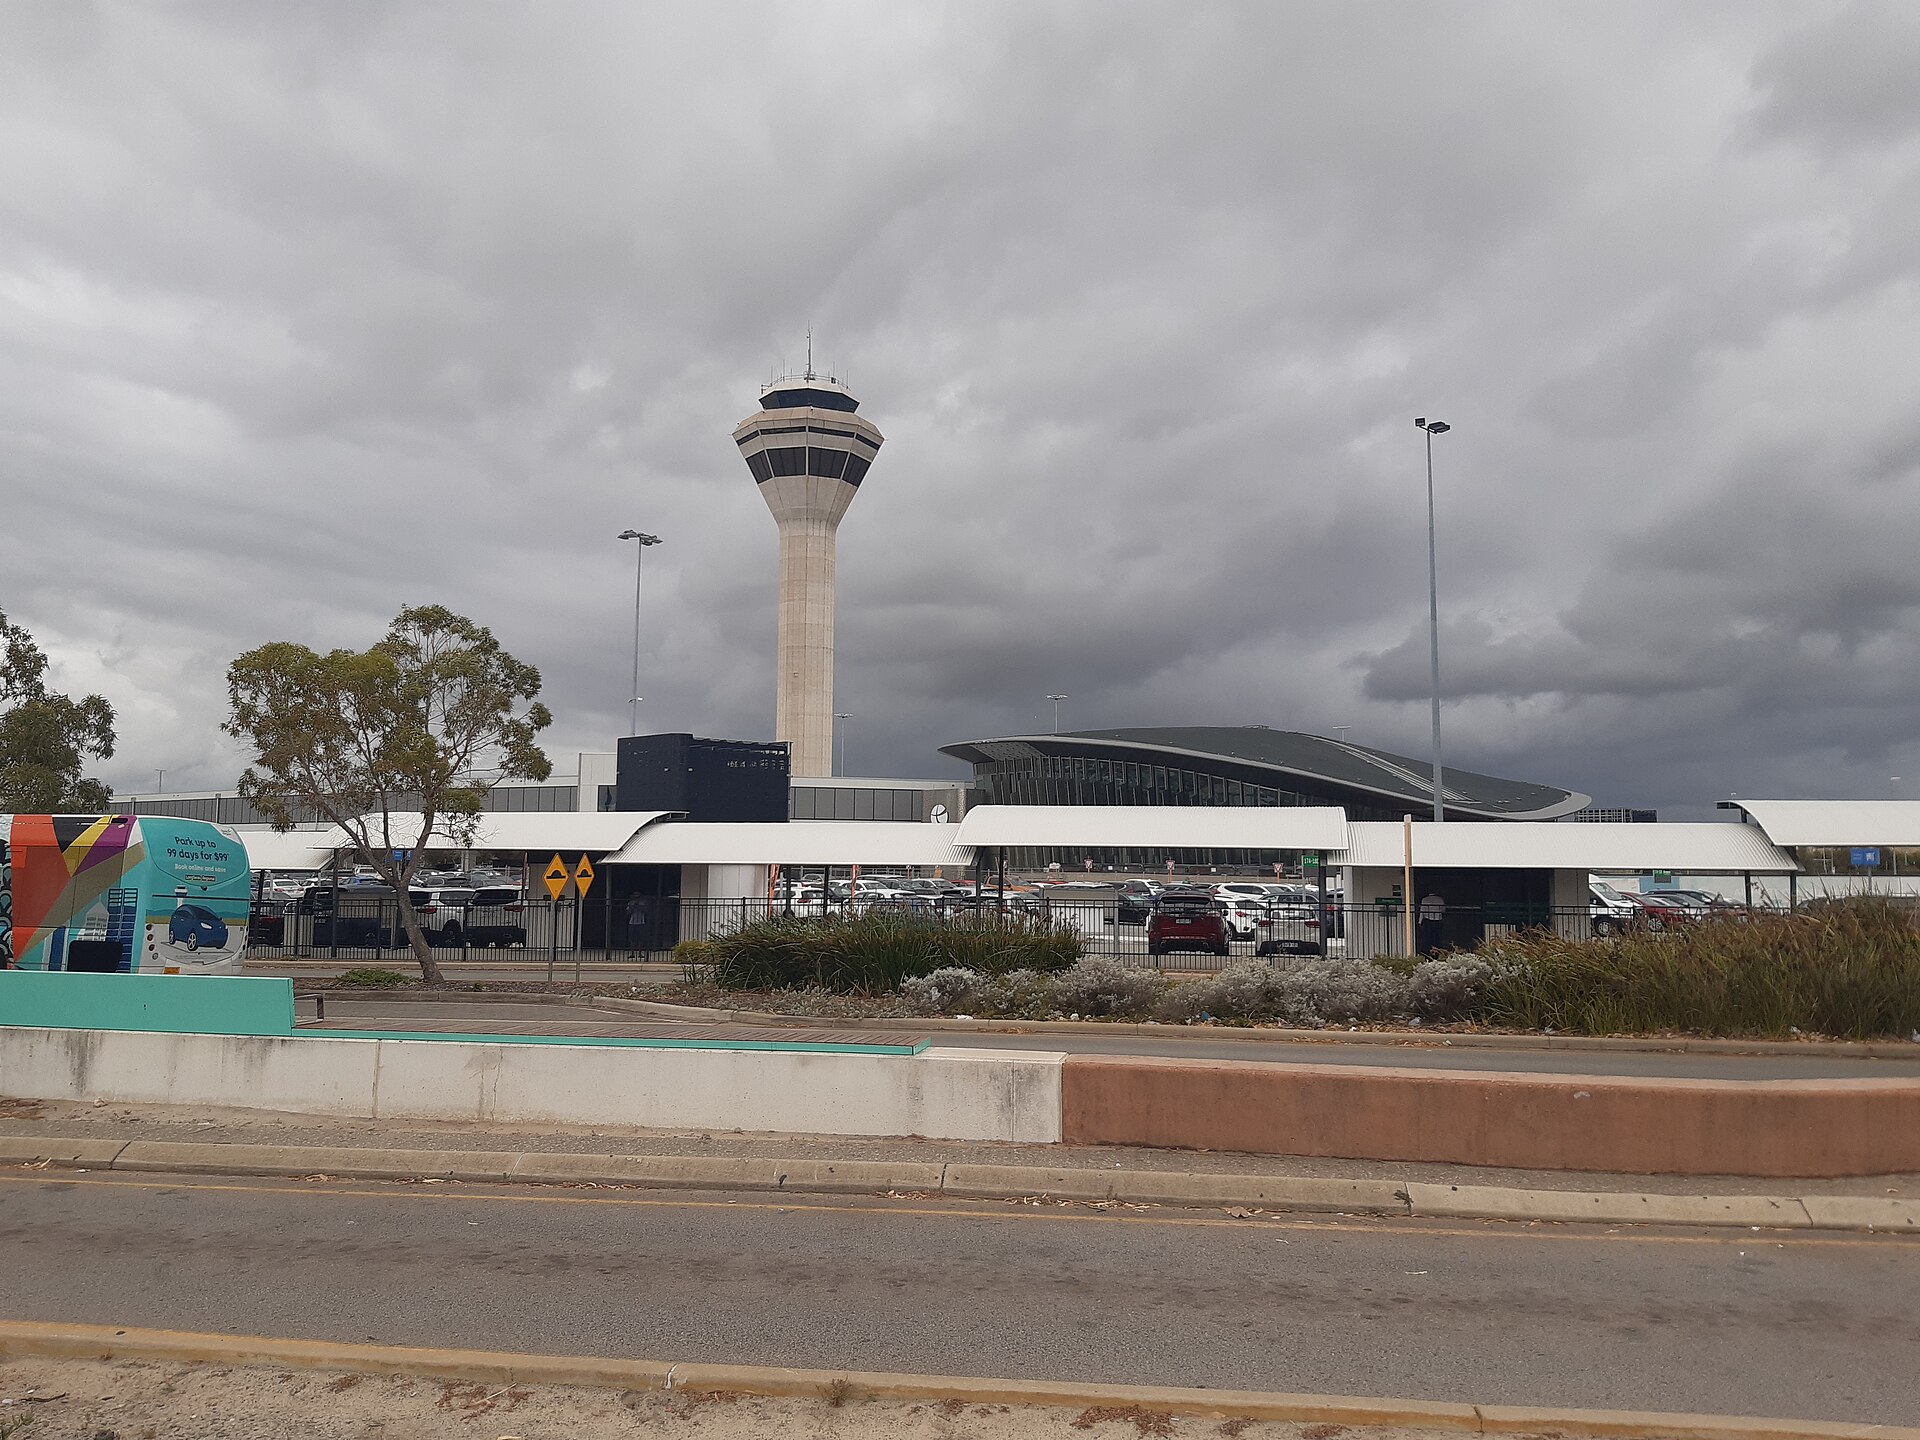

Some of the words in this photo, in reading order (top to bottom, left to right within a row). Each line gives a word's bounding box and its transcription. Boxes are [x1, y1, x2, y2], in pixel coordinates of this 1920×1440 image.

[174, 836, 194, 846] Park
[195, 839, 206, 849] up
[207, 840, 217, 848] to
[167, 848, 177, 857] 99
[179, 849, 199, 861] days
[200, 850, 212, 860] for
